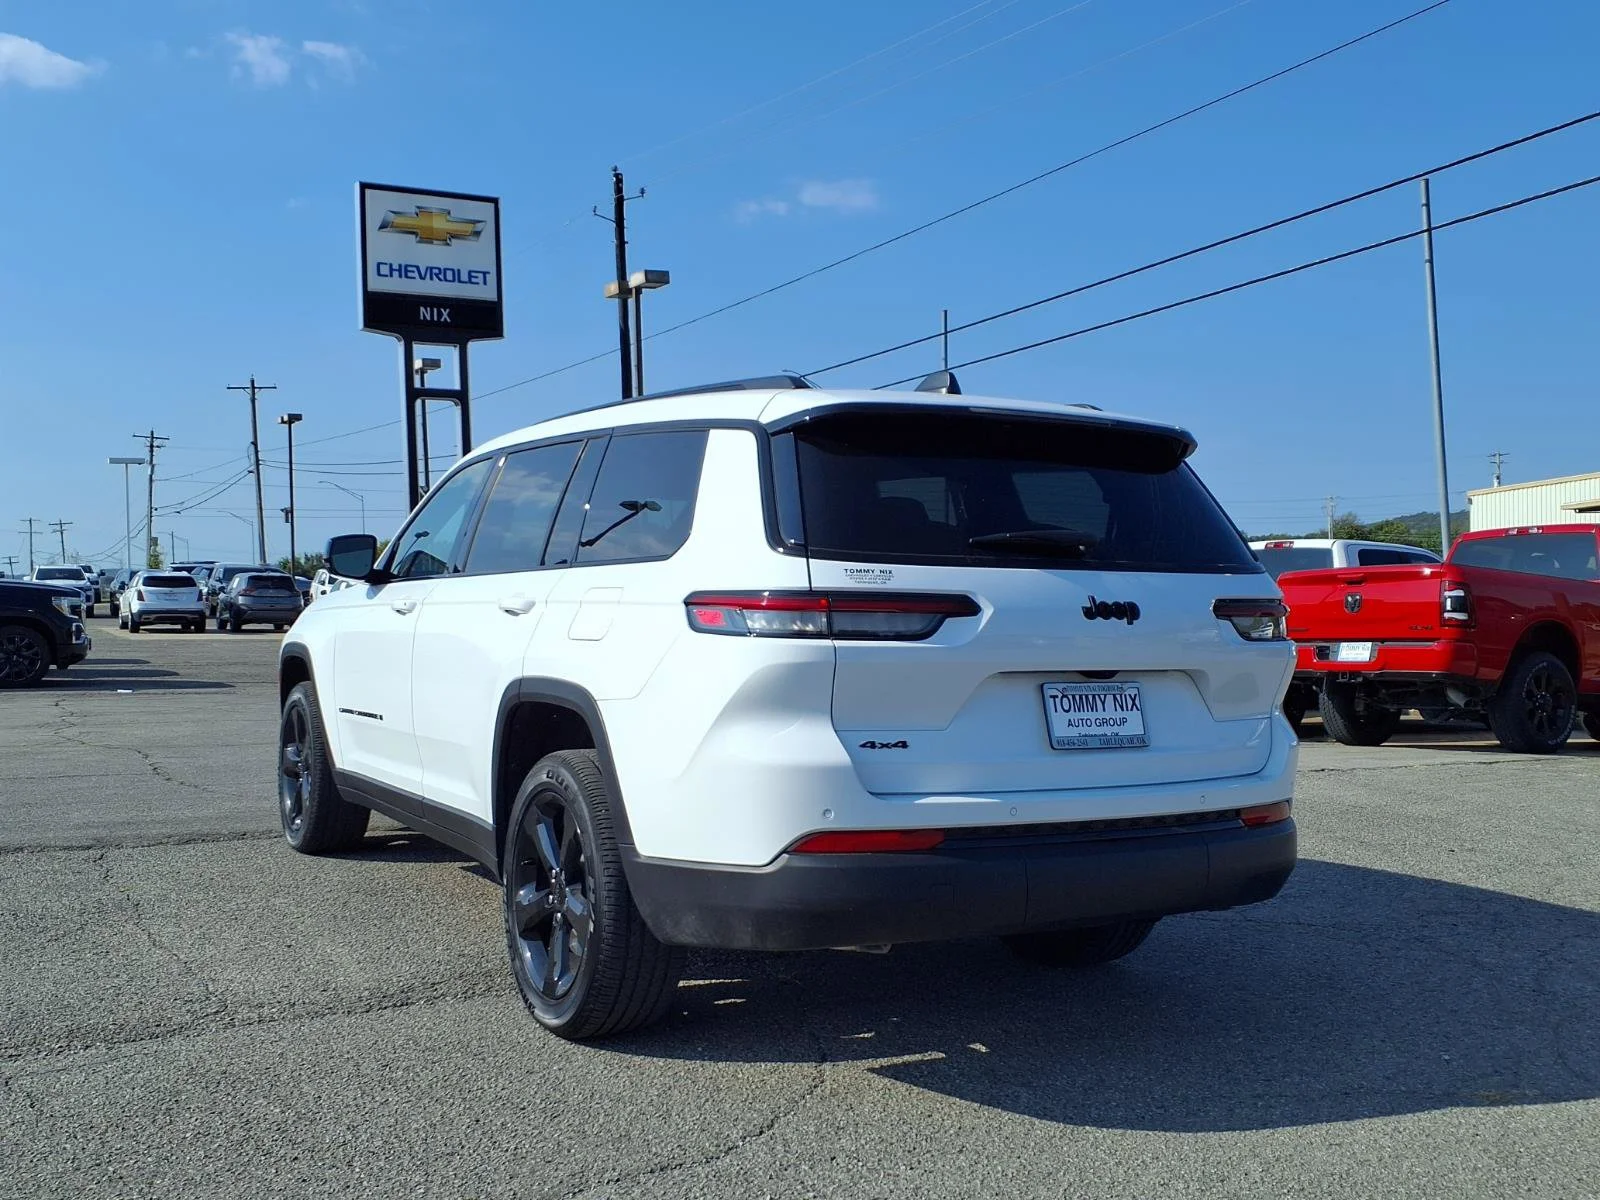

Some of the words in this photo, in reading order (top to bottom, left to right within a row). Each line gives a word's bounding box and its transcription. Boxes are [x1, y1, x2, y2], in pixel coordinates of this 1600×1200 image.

[376, 261, 490, 286] CHEVROLET
[419, 306, 451, 323] NIX
[1081, 595, 1140, 625] Jeep
[1049, 694, 1108, 713] TOMMY
[1113, 693, 1140, 712] NIX
[1067, 718, 1092, 728] AUTO
[1094, 717, 1128, 727] GROUP
[859, 740, 909, 749] 4x4
